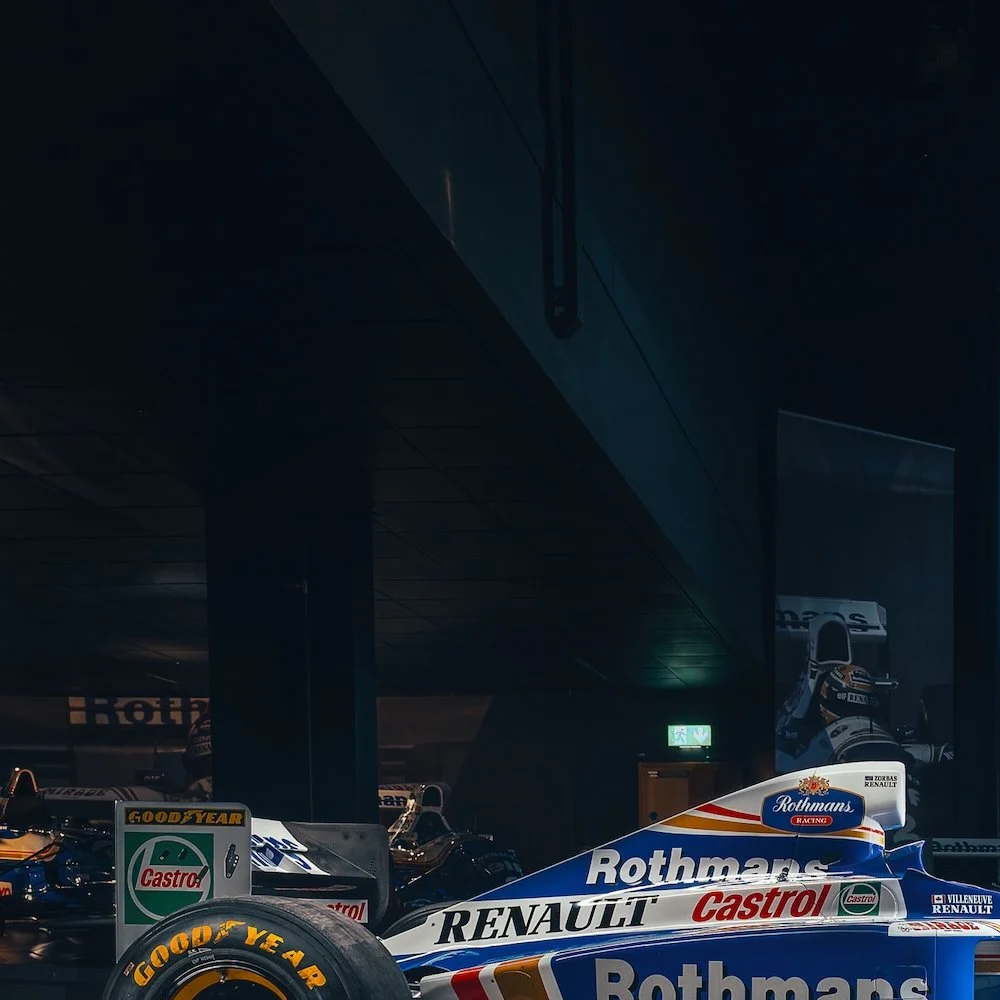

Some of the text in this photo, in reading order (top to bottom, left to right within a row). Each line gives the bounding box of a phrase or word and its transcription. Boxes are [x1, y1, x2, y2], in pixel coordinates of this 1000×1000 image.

[771, 795, 855, 814] Rothmans
[796, 817, 827, 825] RACING
[586, 847, 829, 887] Rothmans
[691, 884, 832, 923] Castrol
[846, 895, 877, 904] Castrol
[947, 894, 993, 904] VILLENEUVE
[932, 904, 993, 915] RENAULT
[435, 894, 659, 944] RENAULT
